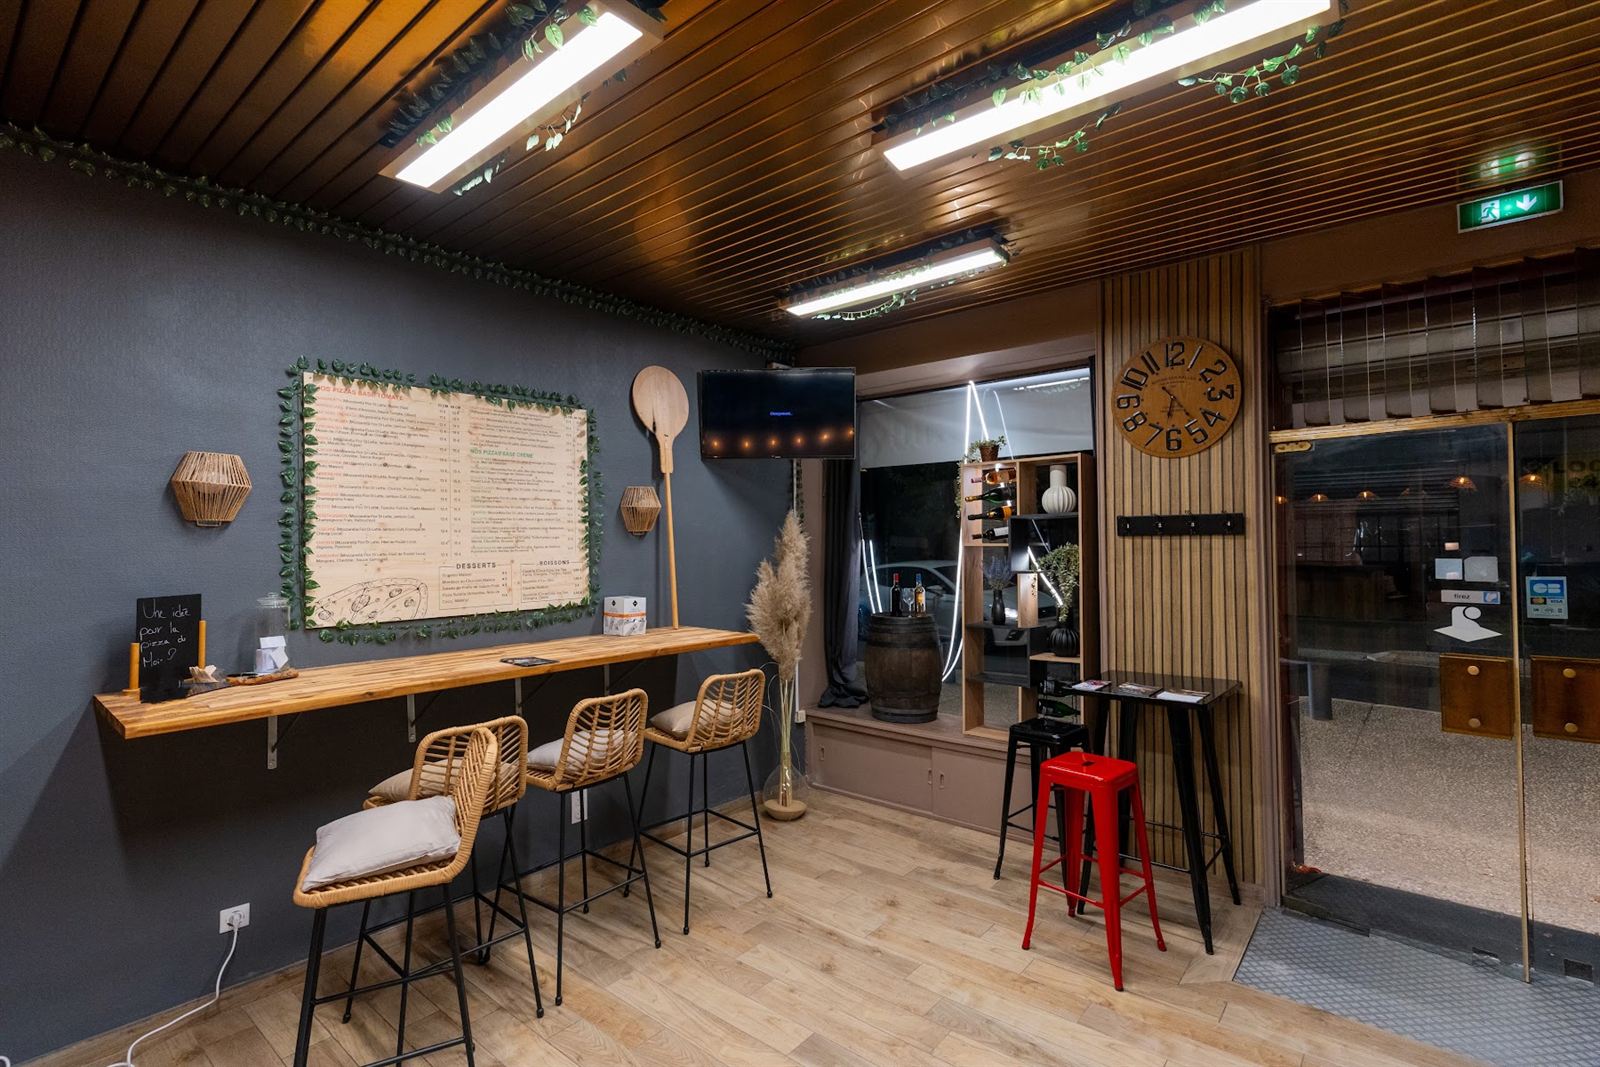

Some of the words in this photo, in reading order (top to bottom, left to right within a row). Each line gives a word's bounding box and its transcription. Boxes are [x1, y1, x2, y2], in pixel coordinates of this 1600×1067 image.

[1141, 351, 1160, 375] 11
[1165, 342, 1185, 368] 12
[1188, 345, 1204, 369] 1
[1120, 367, 1149, 391] 10
[1200, 359, 1227, 383] 2
[1116, 394, 1140, 409] 9
[1207, 384, 1234, 402] 3
[1123, 411, 1147, 432] 8
[1200, 408, 1225, 427] 4
[1144, 423, 1164, 447] 7
[1166, 428, 1182, 451] 6
[1184, 419, 1208, 444] 5
[143, 598, 167, 618] Une
[140, 627, 162, 641] pour
[170, 621, 180, 634] la
[140, 640, 170, 653] pizza
[177, 635, 186, 643] du
